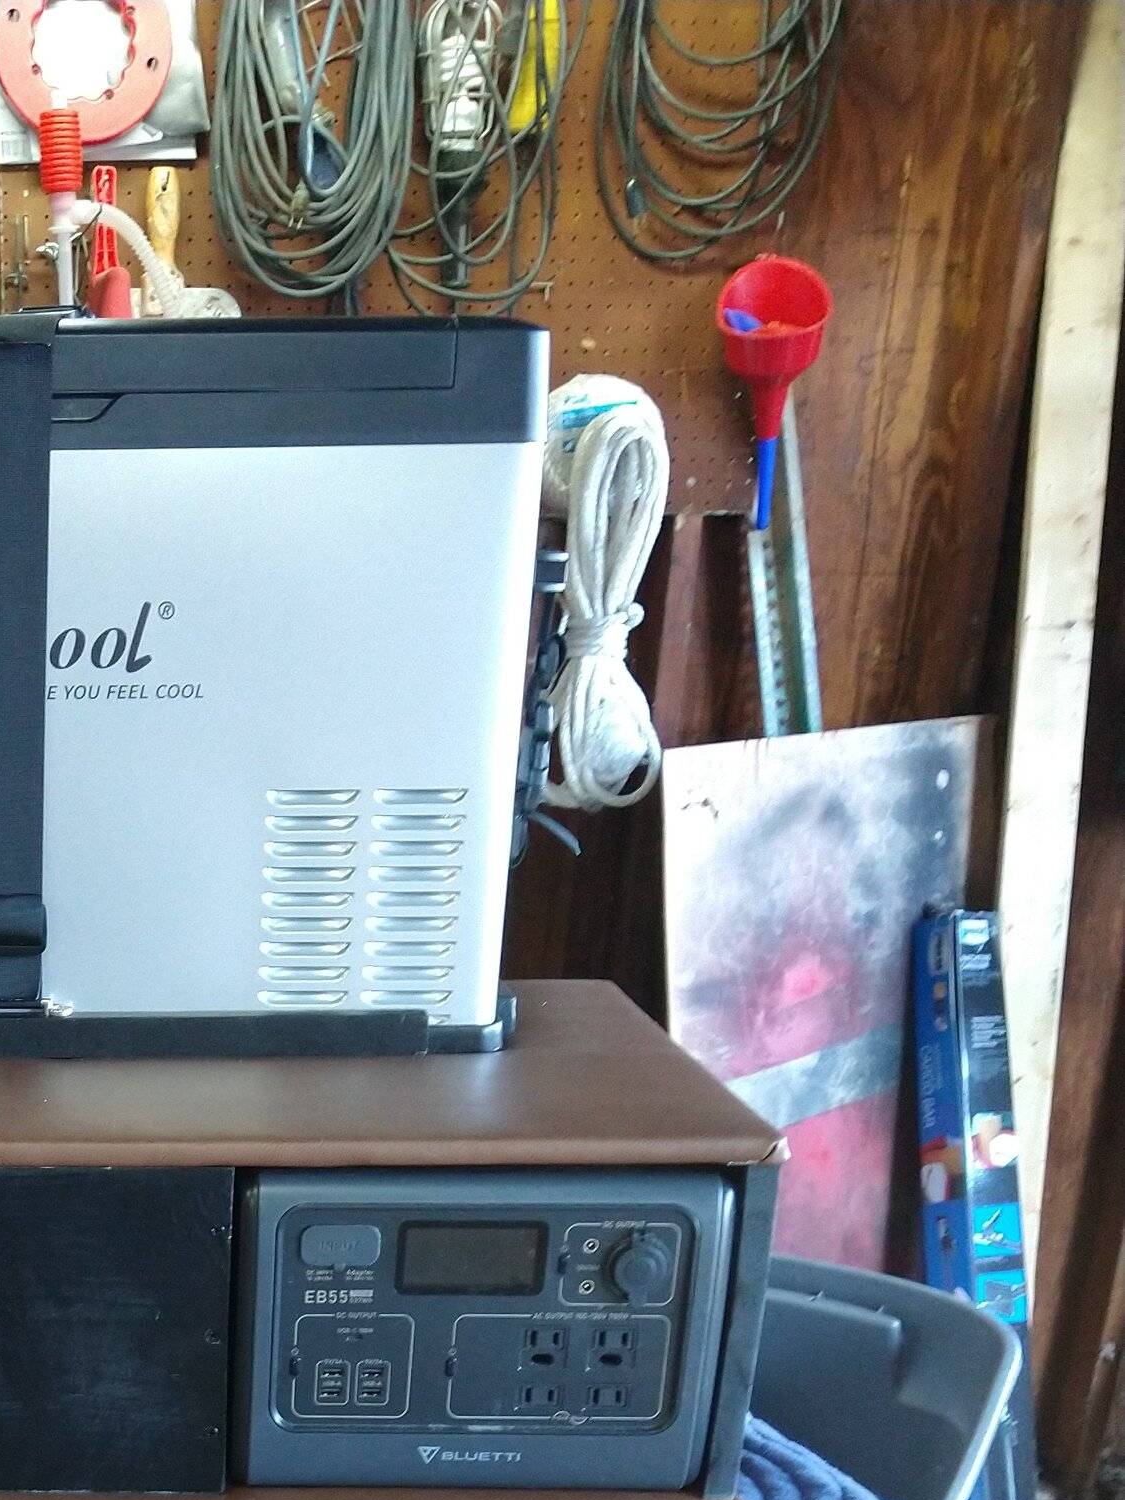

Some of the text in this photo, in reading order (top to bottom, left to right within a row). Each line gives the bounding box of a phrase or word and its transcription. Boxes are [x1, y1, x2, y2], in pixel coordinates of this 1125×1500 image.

[64, 684, 102, 700] YOU
[106, 683, 149, 700] FEEL
[155, 683, 205, 699] COOL
[303, 1289, 350, 1304] EB55
[441, 1451, 522, 1462] BLUETTI
